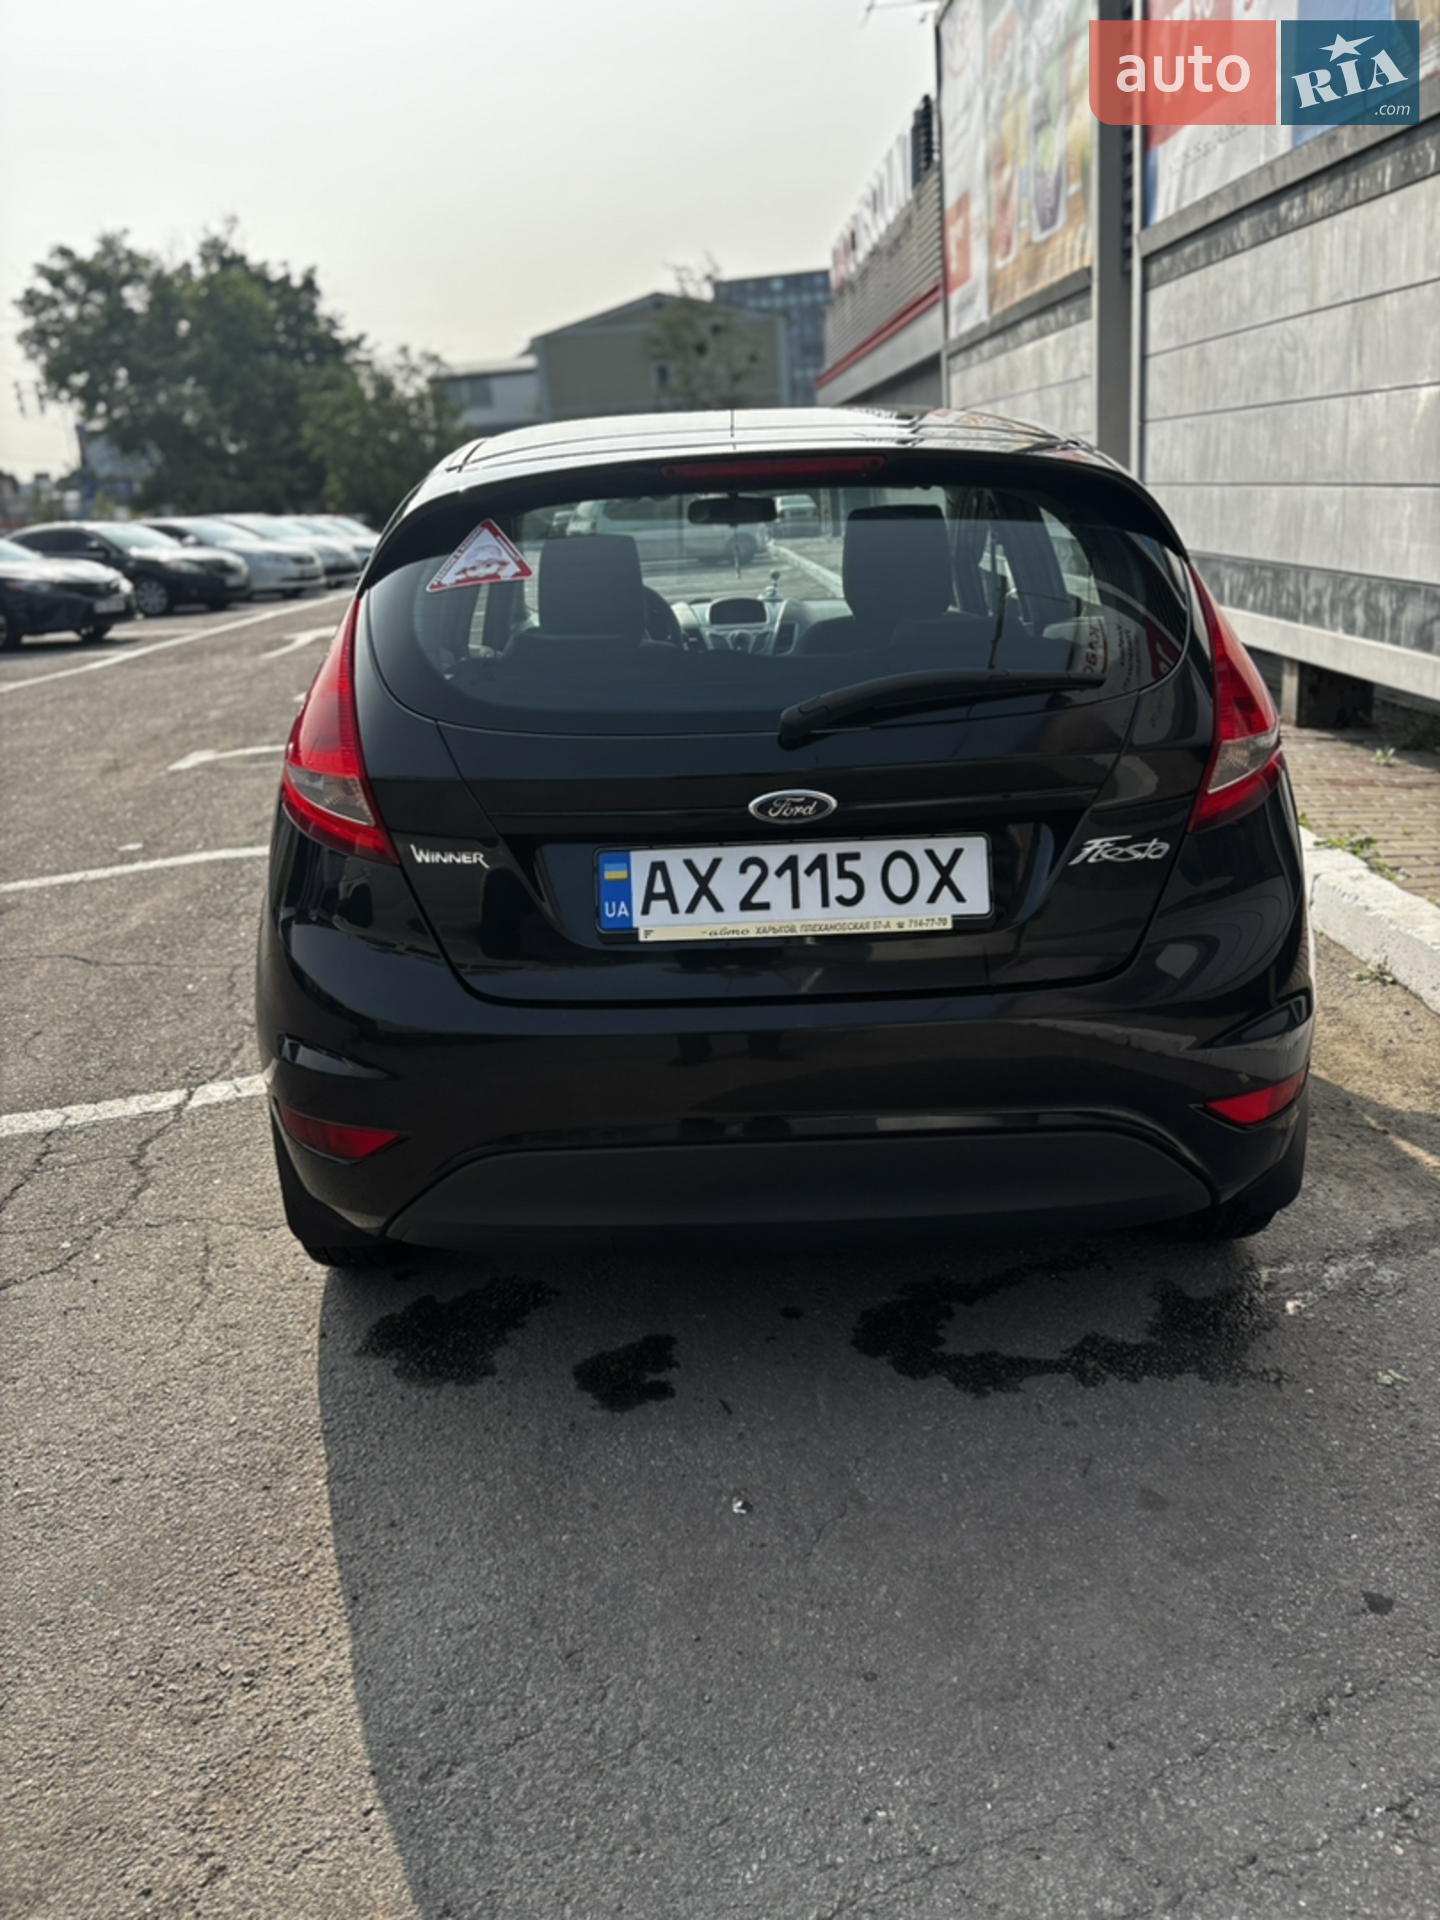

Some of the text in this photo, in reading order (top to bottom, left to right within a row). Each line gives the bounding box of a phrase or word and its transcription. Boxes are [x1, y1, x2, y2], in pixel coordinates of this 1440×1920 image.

[768, 797, 818, 817] Ford
[410, 844, 490, 869] WINNER
[1067, 834, 1170, 866] Fiesta
[640, 848, 967, 916] AX 2115 OX
[604, 901, 629, 918] UA
